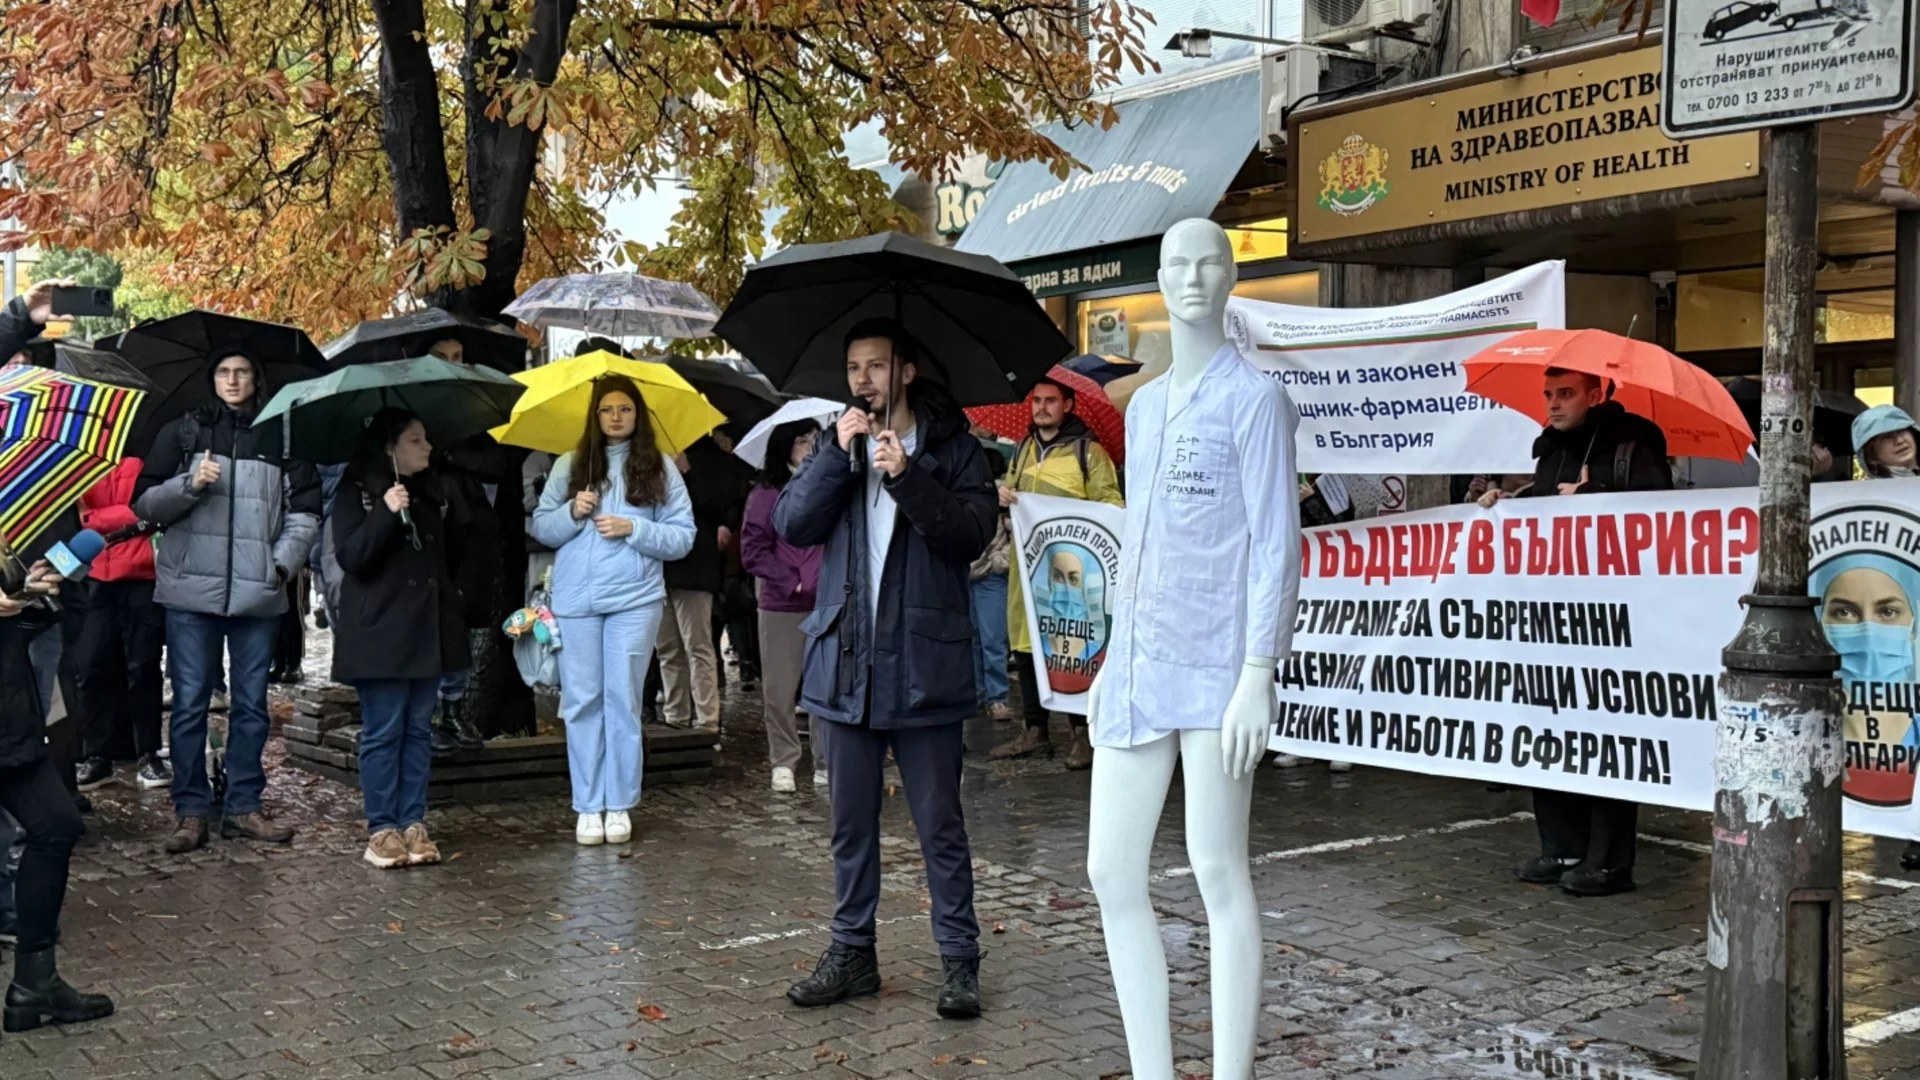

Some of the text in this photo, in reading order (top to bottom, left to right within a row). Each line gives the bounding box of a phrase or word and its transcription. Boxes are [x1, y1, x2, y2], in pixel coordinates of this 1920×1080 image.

[1715, 41, 1828, 68] Нарушителите
[1680, 66, 1773, 89] отстраняват
[1455, 71, 1663, 132] МИНИСТЕРСТВ
[1707, 93, 1740, 110] 0700
[1746, 92, 1758, 105] 13
[1764, 87, 1789, 101] 233
[1793, 88, 1804, 98] от
[1837, 81, 1850, 93] до
[1410, 145, 1443, 169] НА
[1444, 144, 1690, 202] MINISTRY OF HEALTH
[1006, 161, 1188, 225] dried fruits & nuts
[1063, 267, 1079, 283] за
[1083, 260, 1122, 284] ядки
[1263, 361, 1457, 385] остоен и законен
[1315, 431, 1434, 452] в България
[1175, 448, 1199, 463] БГ
[1090, 532, 1120, 587] ПРОТЕС
[1313, 520, 1465, 586] БЪДЕЩЕ
[1466, 519, 1495, 576] В
[1502, 506, 1759, 577] БЪЛГАРИЯ?
[1038, 615, 1095, 641] БЪДЕЩЕ
[1399, 598, 1433, 637] ЗА
[1439, 598, 1632, 648] СЪВРЕМЕННИ
[1062, 640, 1070, 654] В
[1275, 649, 1366, 695] ДЕНИЯ,
[1371, 655, 1577, 714] МОТИВИРАЩИ
[1866, 717, 1880, 740] В
[1345, 709, 1363, 748] И
[1370, 711, 1477, 762] РАБОТА
[1483, 722, 1503, 765] В
[1511, 725, 1672, 785] СФЕРАТА!
